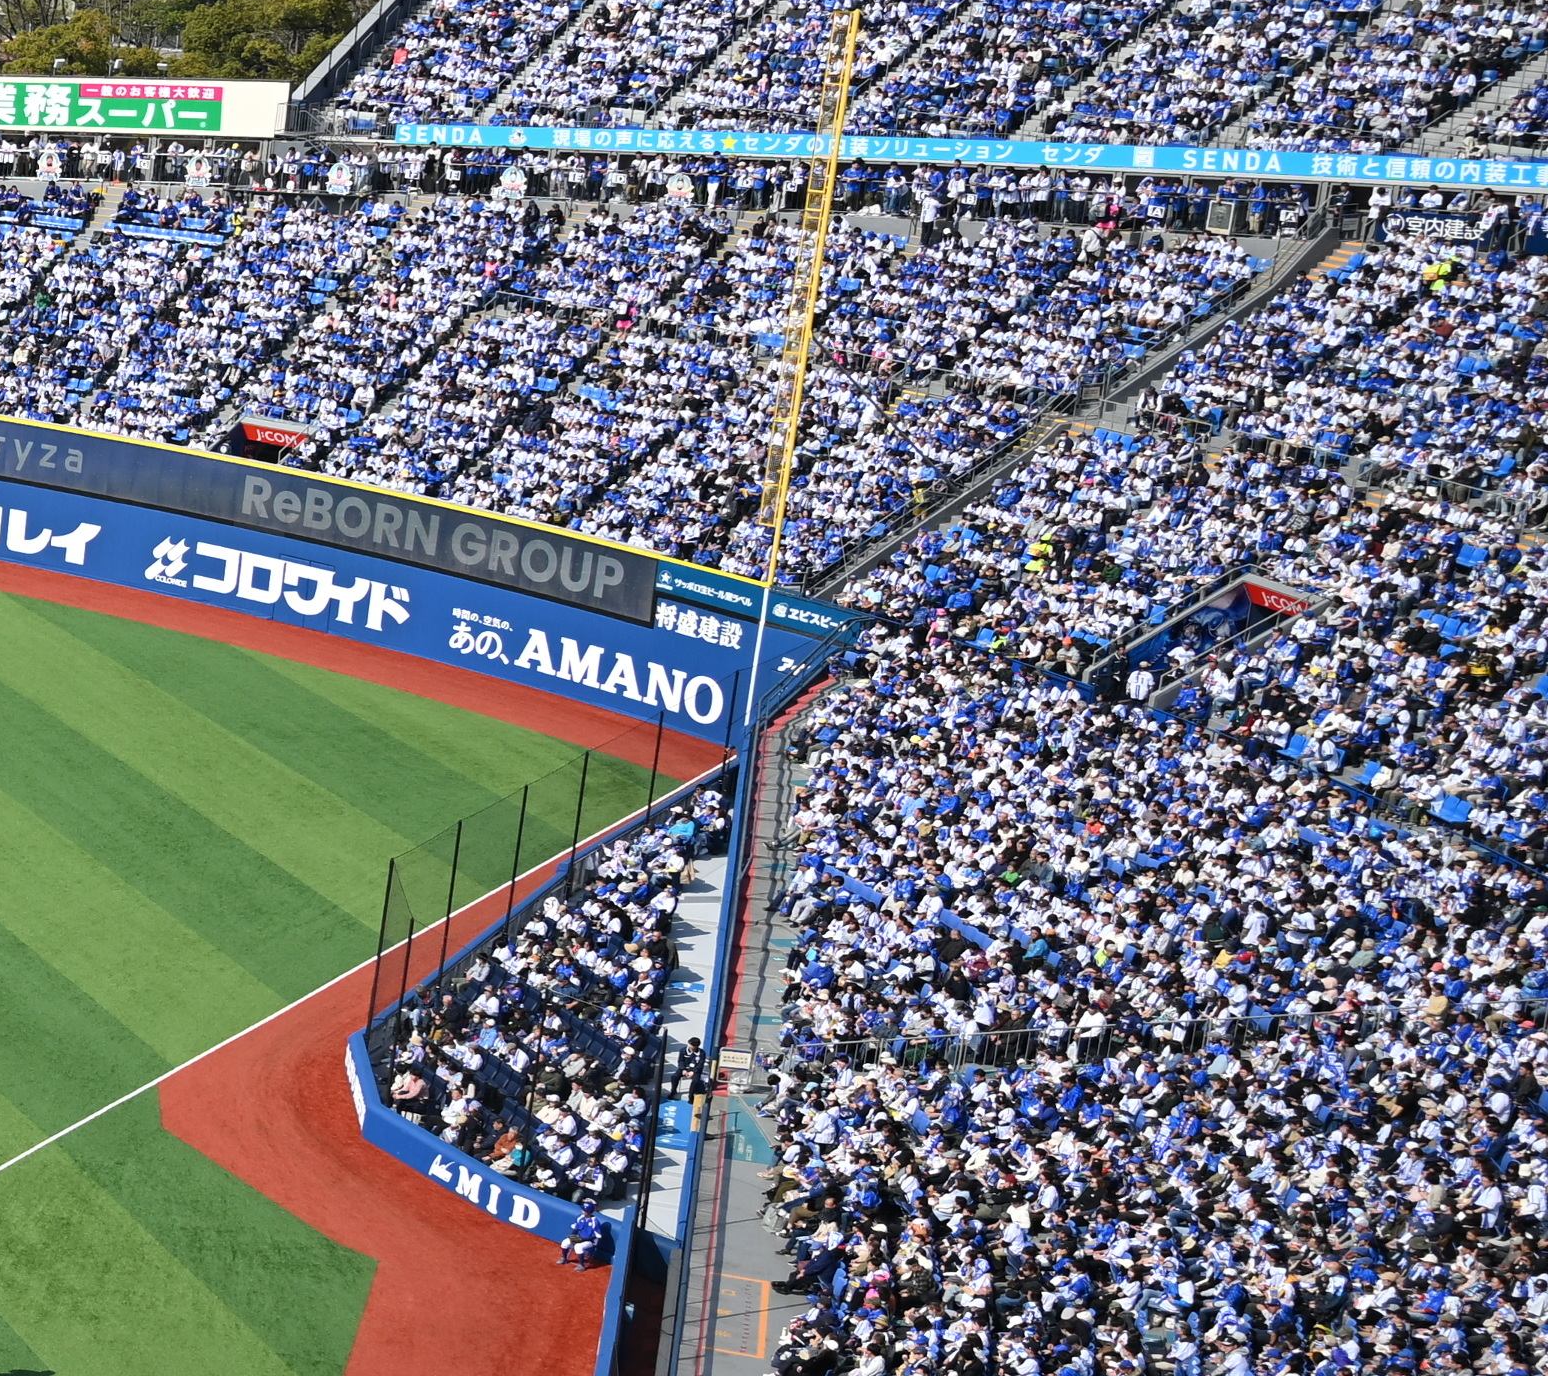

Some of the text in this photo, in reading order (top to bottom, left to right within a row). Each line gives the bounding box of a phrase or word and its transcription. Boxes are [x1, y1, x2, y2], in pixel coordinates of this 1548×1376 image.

[85, 85, 217, 101] 一般のお客様大歓迎
[398, 125, 483, 147] SENDA
[1182, 150, 1283, 173] SENDA
[254, 429, 298, 447] J:COM
[240, 474, 625, 599] ReBORN GROUP
[192, 541, 411, 633] コロワイド
[674, 577, 754, 607] サッポロ生ビール黒ラベル
[655, 602, 744, 650] 将盛建設
[449, 625, 724, 726] あの、 AMANO
